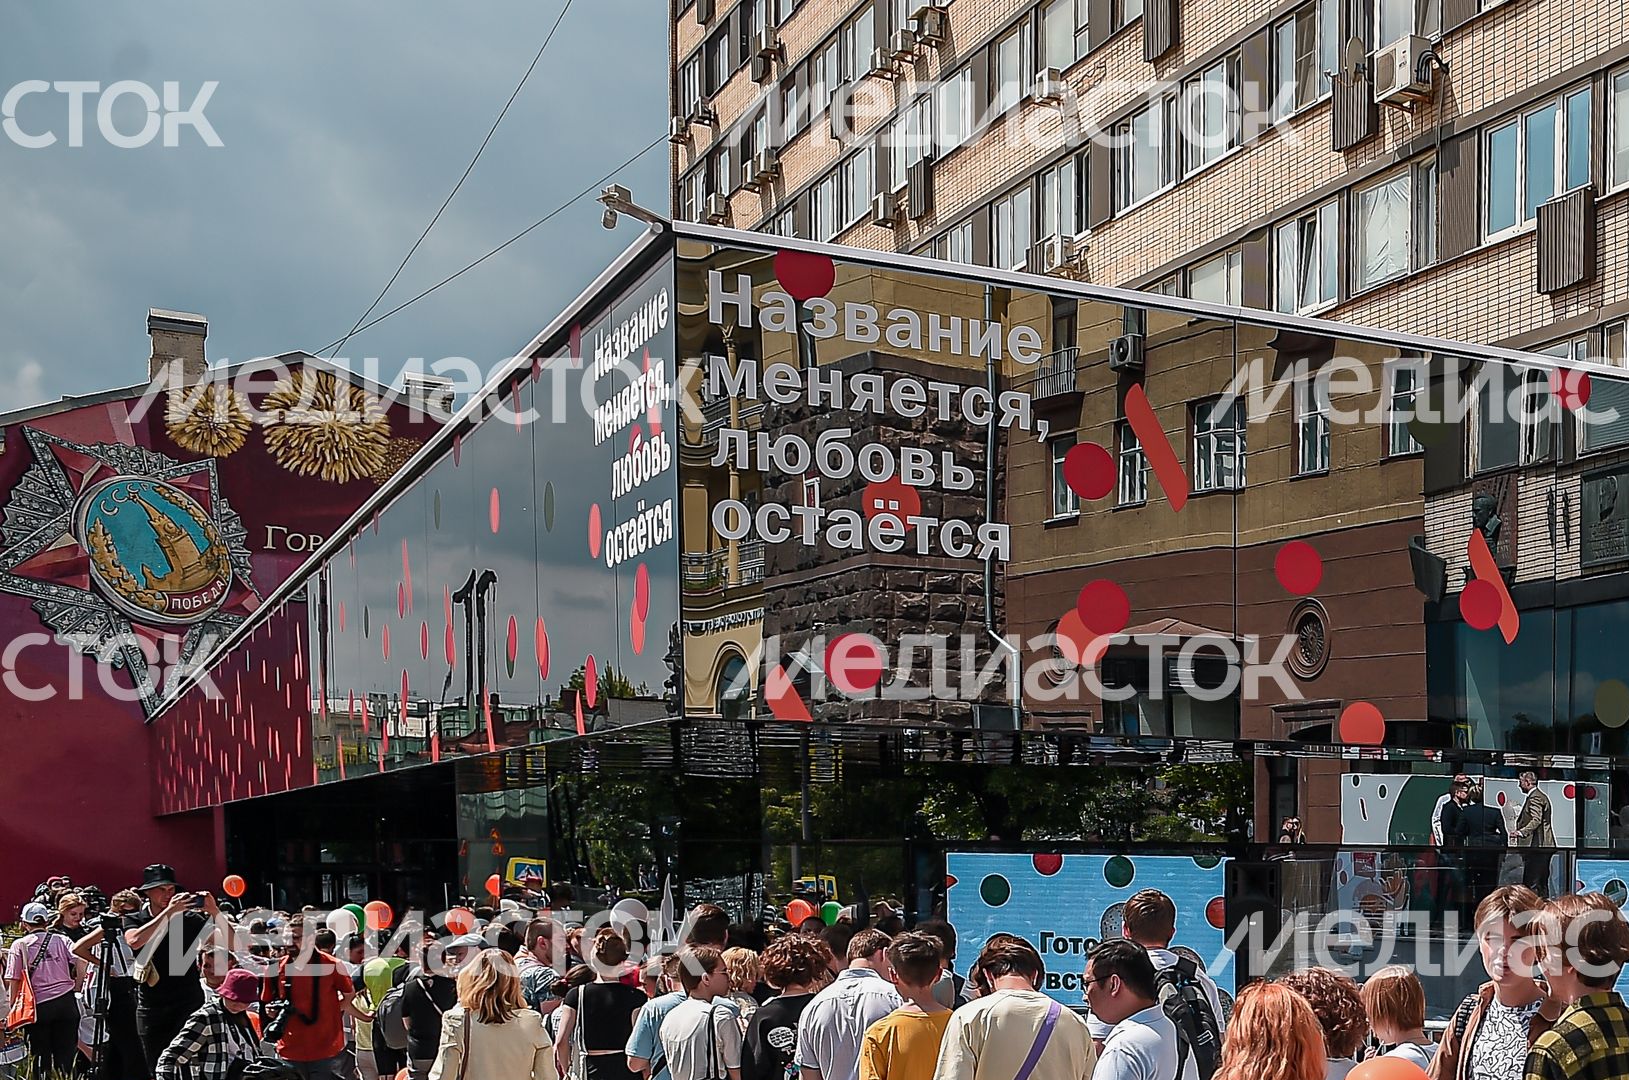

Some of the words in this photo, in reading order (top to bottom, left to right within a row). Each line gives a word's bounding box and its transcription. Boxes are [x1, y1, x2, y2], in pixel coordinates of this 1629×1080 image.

[594, 287, 669, 382] Название
[707, 269, 1044, 365] Название
[593, 359, 670, 446] меняется,
[708, 351, 1050, 443] меняется,
[611, 430, 671, 500] любовь
[710, 427, 976, 493] любовь
[605, 499, 673, 569] остаётся
[710, 498, 1012, 562] остаётся
[170, 579, 226, 611] ПОБЕДА
